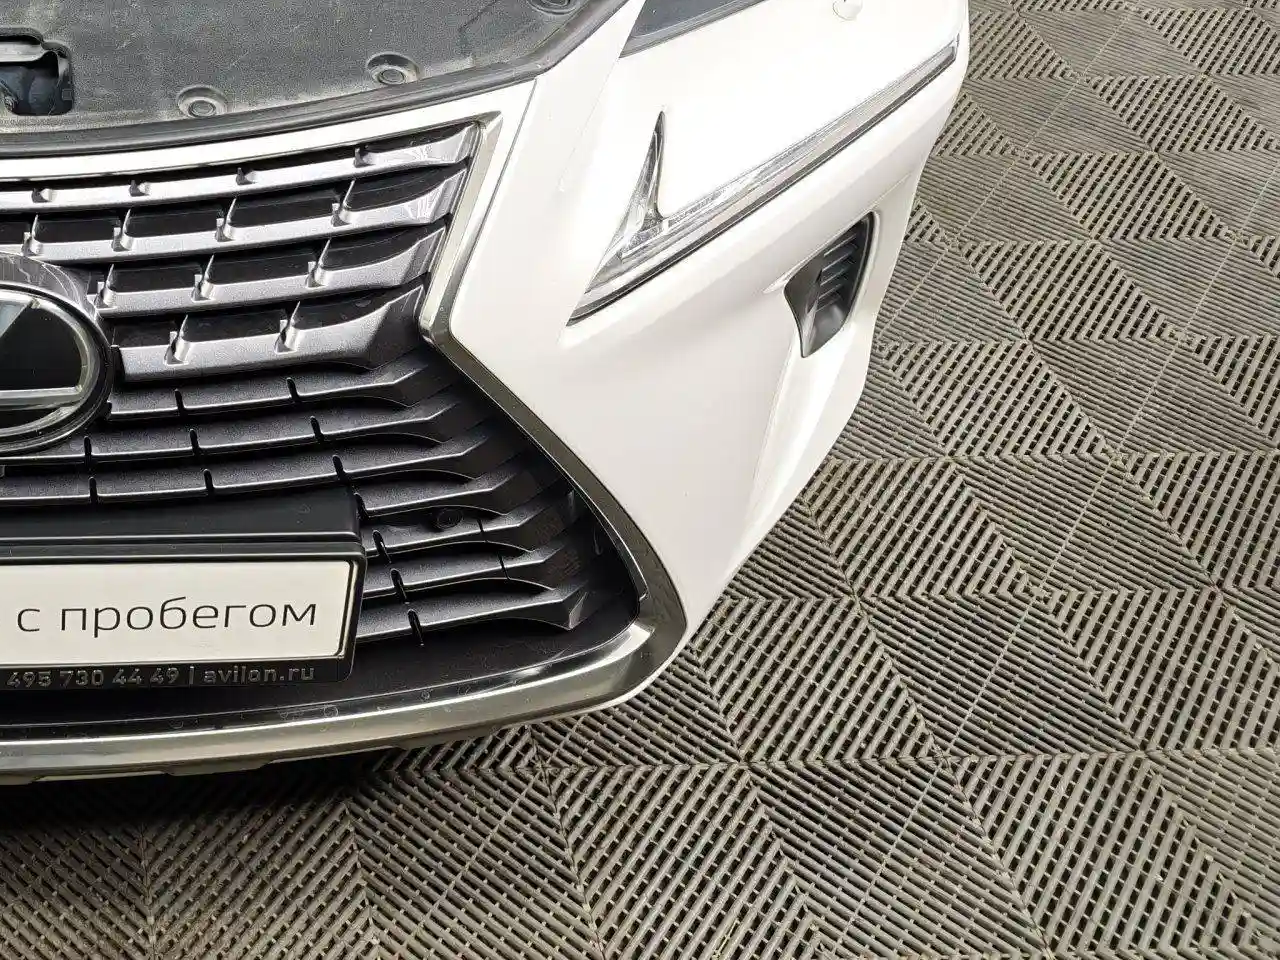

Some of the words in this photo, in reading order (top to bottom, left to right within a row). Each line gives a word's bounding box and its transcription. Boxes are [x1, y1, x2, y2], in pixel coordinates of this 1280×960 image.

[17, 608, 40, 632] с
[61, 596, 317, 638] пробегом
[6, 671, 52, 688] 495
[59, 670, 104, 687] 730
[112, 668, 142, 685] 44
[149, 667, 179, 684] 49
[203, 665, 315, 684] avilon.ru
